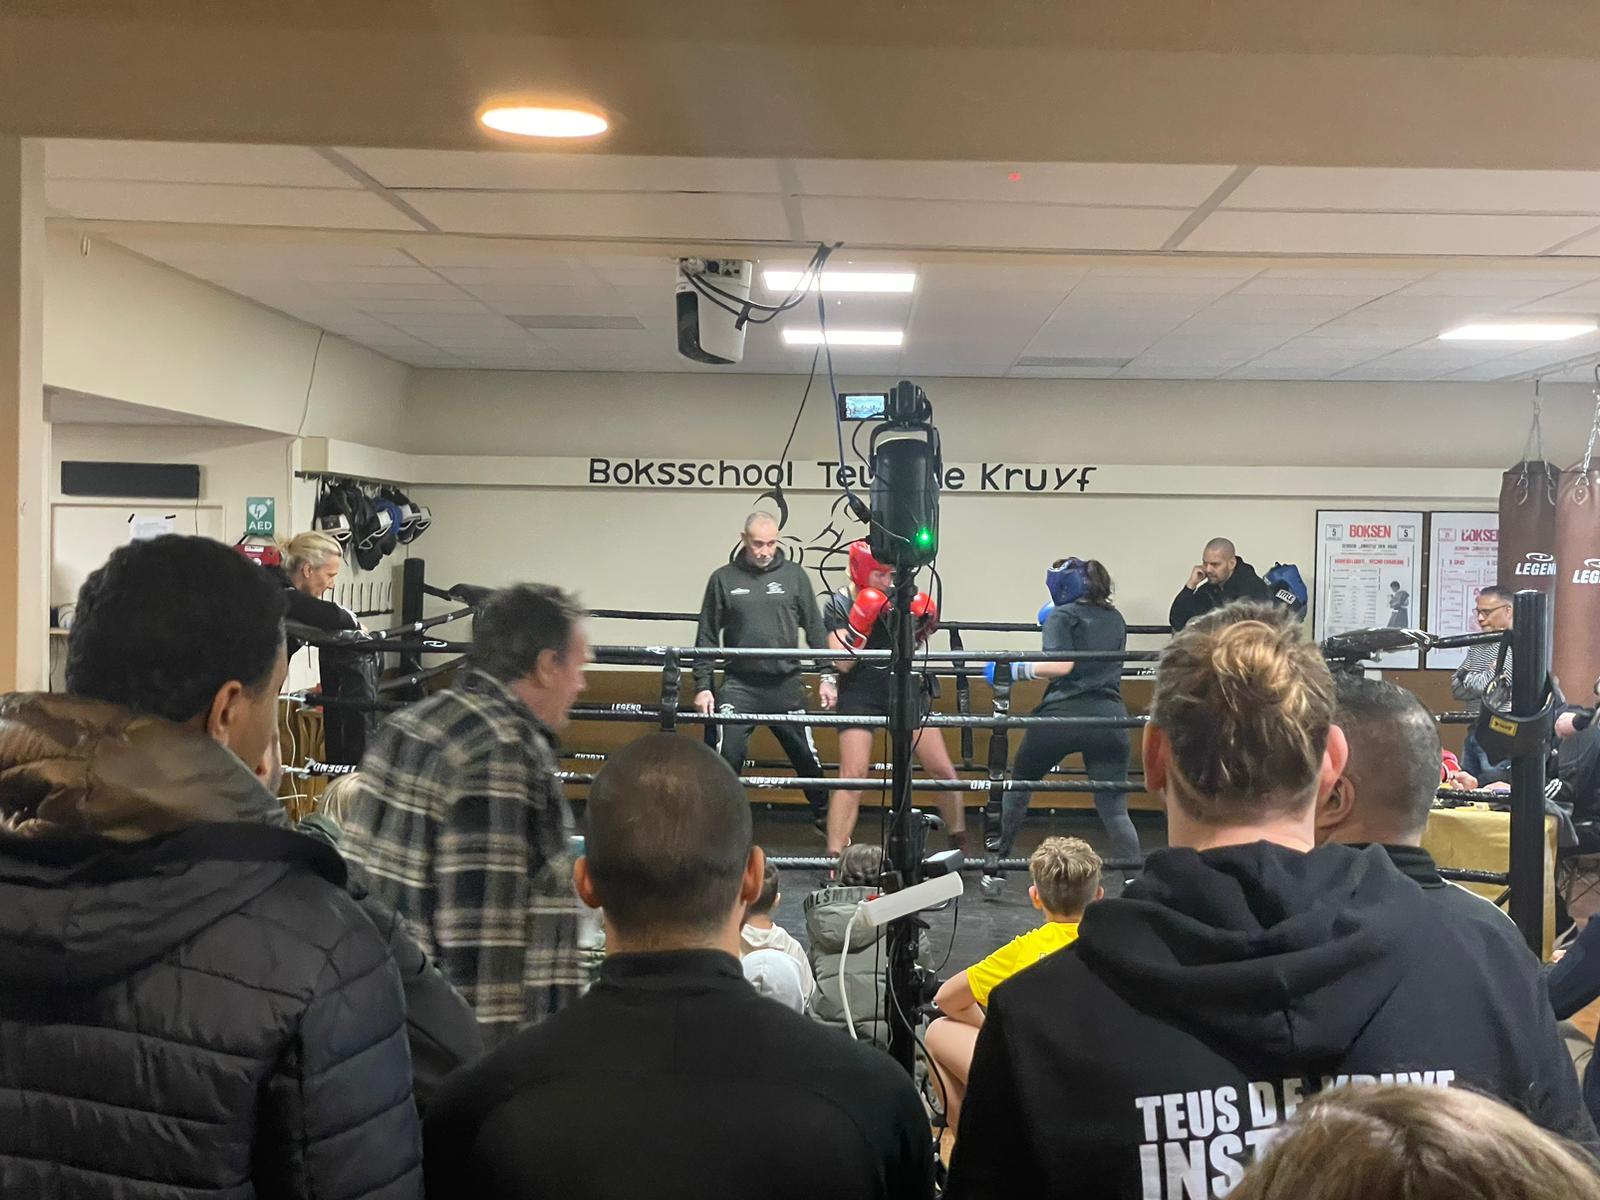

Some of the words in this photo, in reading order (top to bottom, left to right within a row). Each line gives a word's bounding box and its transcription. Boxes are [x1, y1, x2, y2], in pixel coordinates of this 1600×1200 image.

[589, 458, 793, 487] Boksschool
[817, 461, 875, 489] Teu
[981, 463, 1098, 493] Kruyf
[248, 521, 273, 531] AED
[1349, 524, 1392, 538] BOKSEN
[1461, 529, 1499, 543] BOKSE
[1515, 563, 1557, 576] LEGEN
[1572, 569, 1600, 584] LEG
[1278, 590, 1295, 602] TITLE
[611, 703, 642, 711] LEGEND
[1134, 1085, 1240, 1142] TEUS
[1248, 1077, 1305, 1128] DE
[1138, 1128, 1282, 1200] INST
